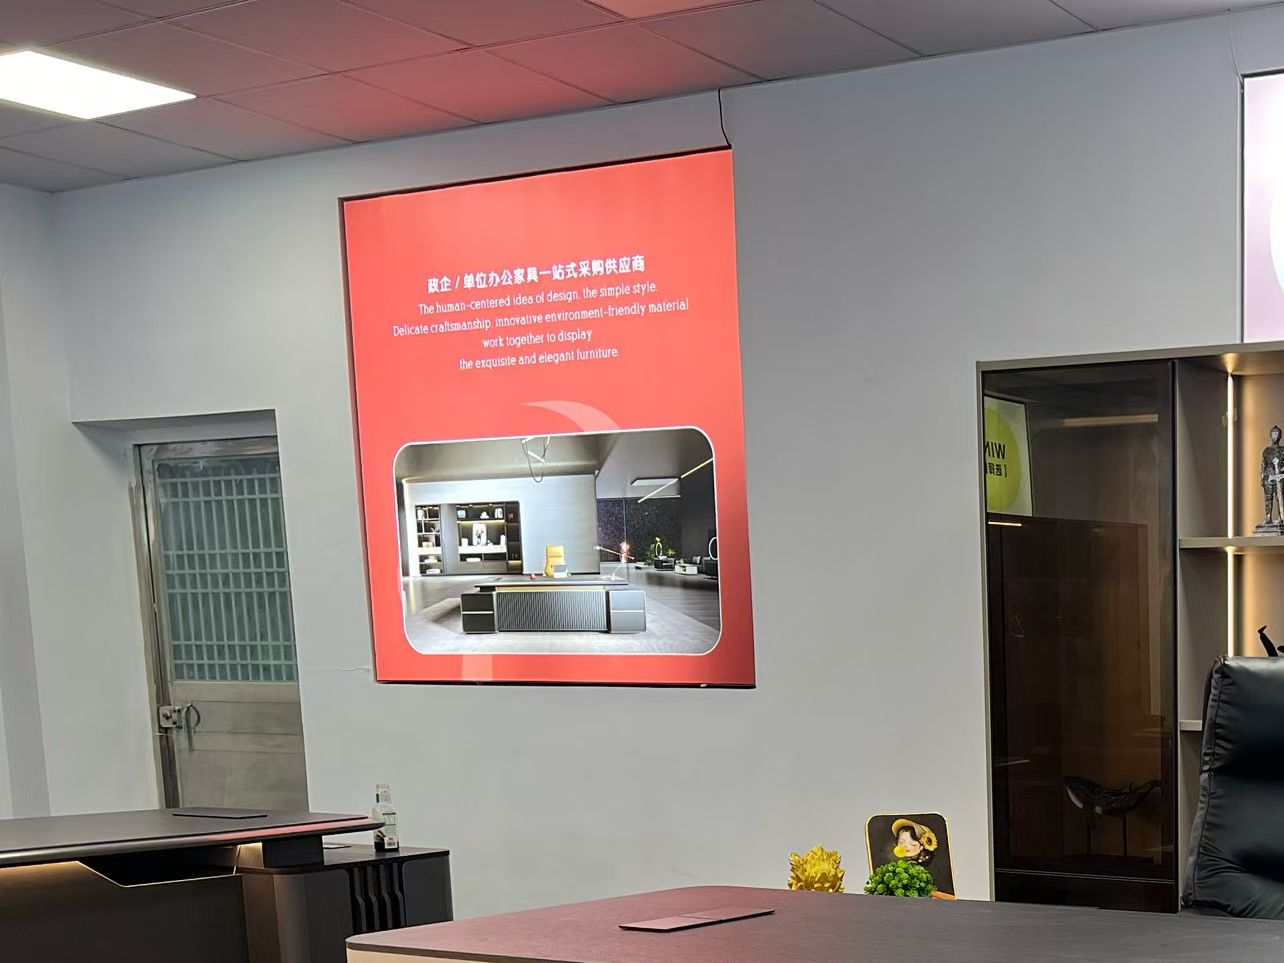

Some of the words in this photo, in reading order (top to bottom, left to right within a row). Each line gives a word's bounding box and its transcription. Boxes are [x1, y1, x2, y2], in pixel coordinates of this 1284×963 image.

[418, 303, 435, 315] The
[436, 294, 511, 313] human-centered
[513, 293, 533, 305] idea
[535, 292, 545, 303] of
[583, 288, 597, 298] the
[600, 285, 630, 299] simple
[393, 324, 428, 337] Delicate
[495, 313, 543, 328] innovative
[545, 303, 645, 323] environment-friendly
[648, 299, 688, 314] material
[482, 336, 504, 348] work
[506, 332, 543, 348] together
[546, 332, 556, 343] to
[558, 329, 592, 343] display
[459, 358, 473, 369] the
[475, 355, 516, 370] exquisite
[518, 353, 537, 365] and
[538, 349, 574, 365] elegant
